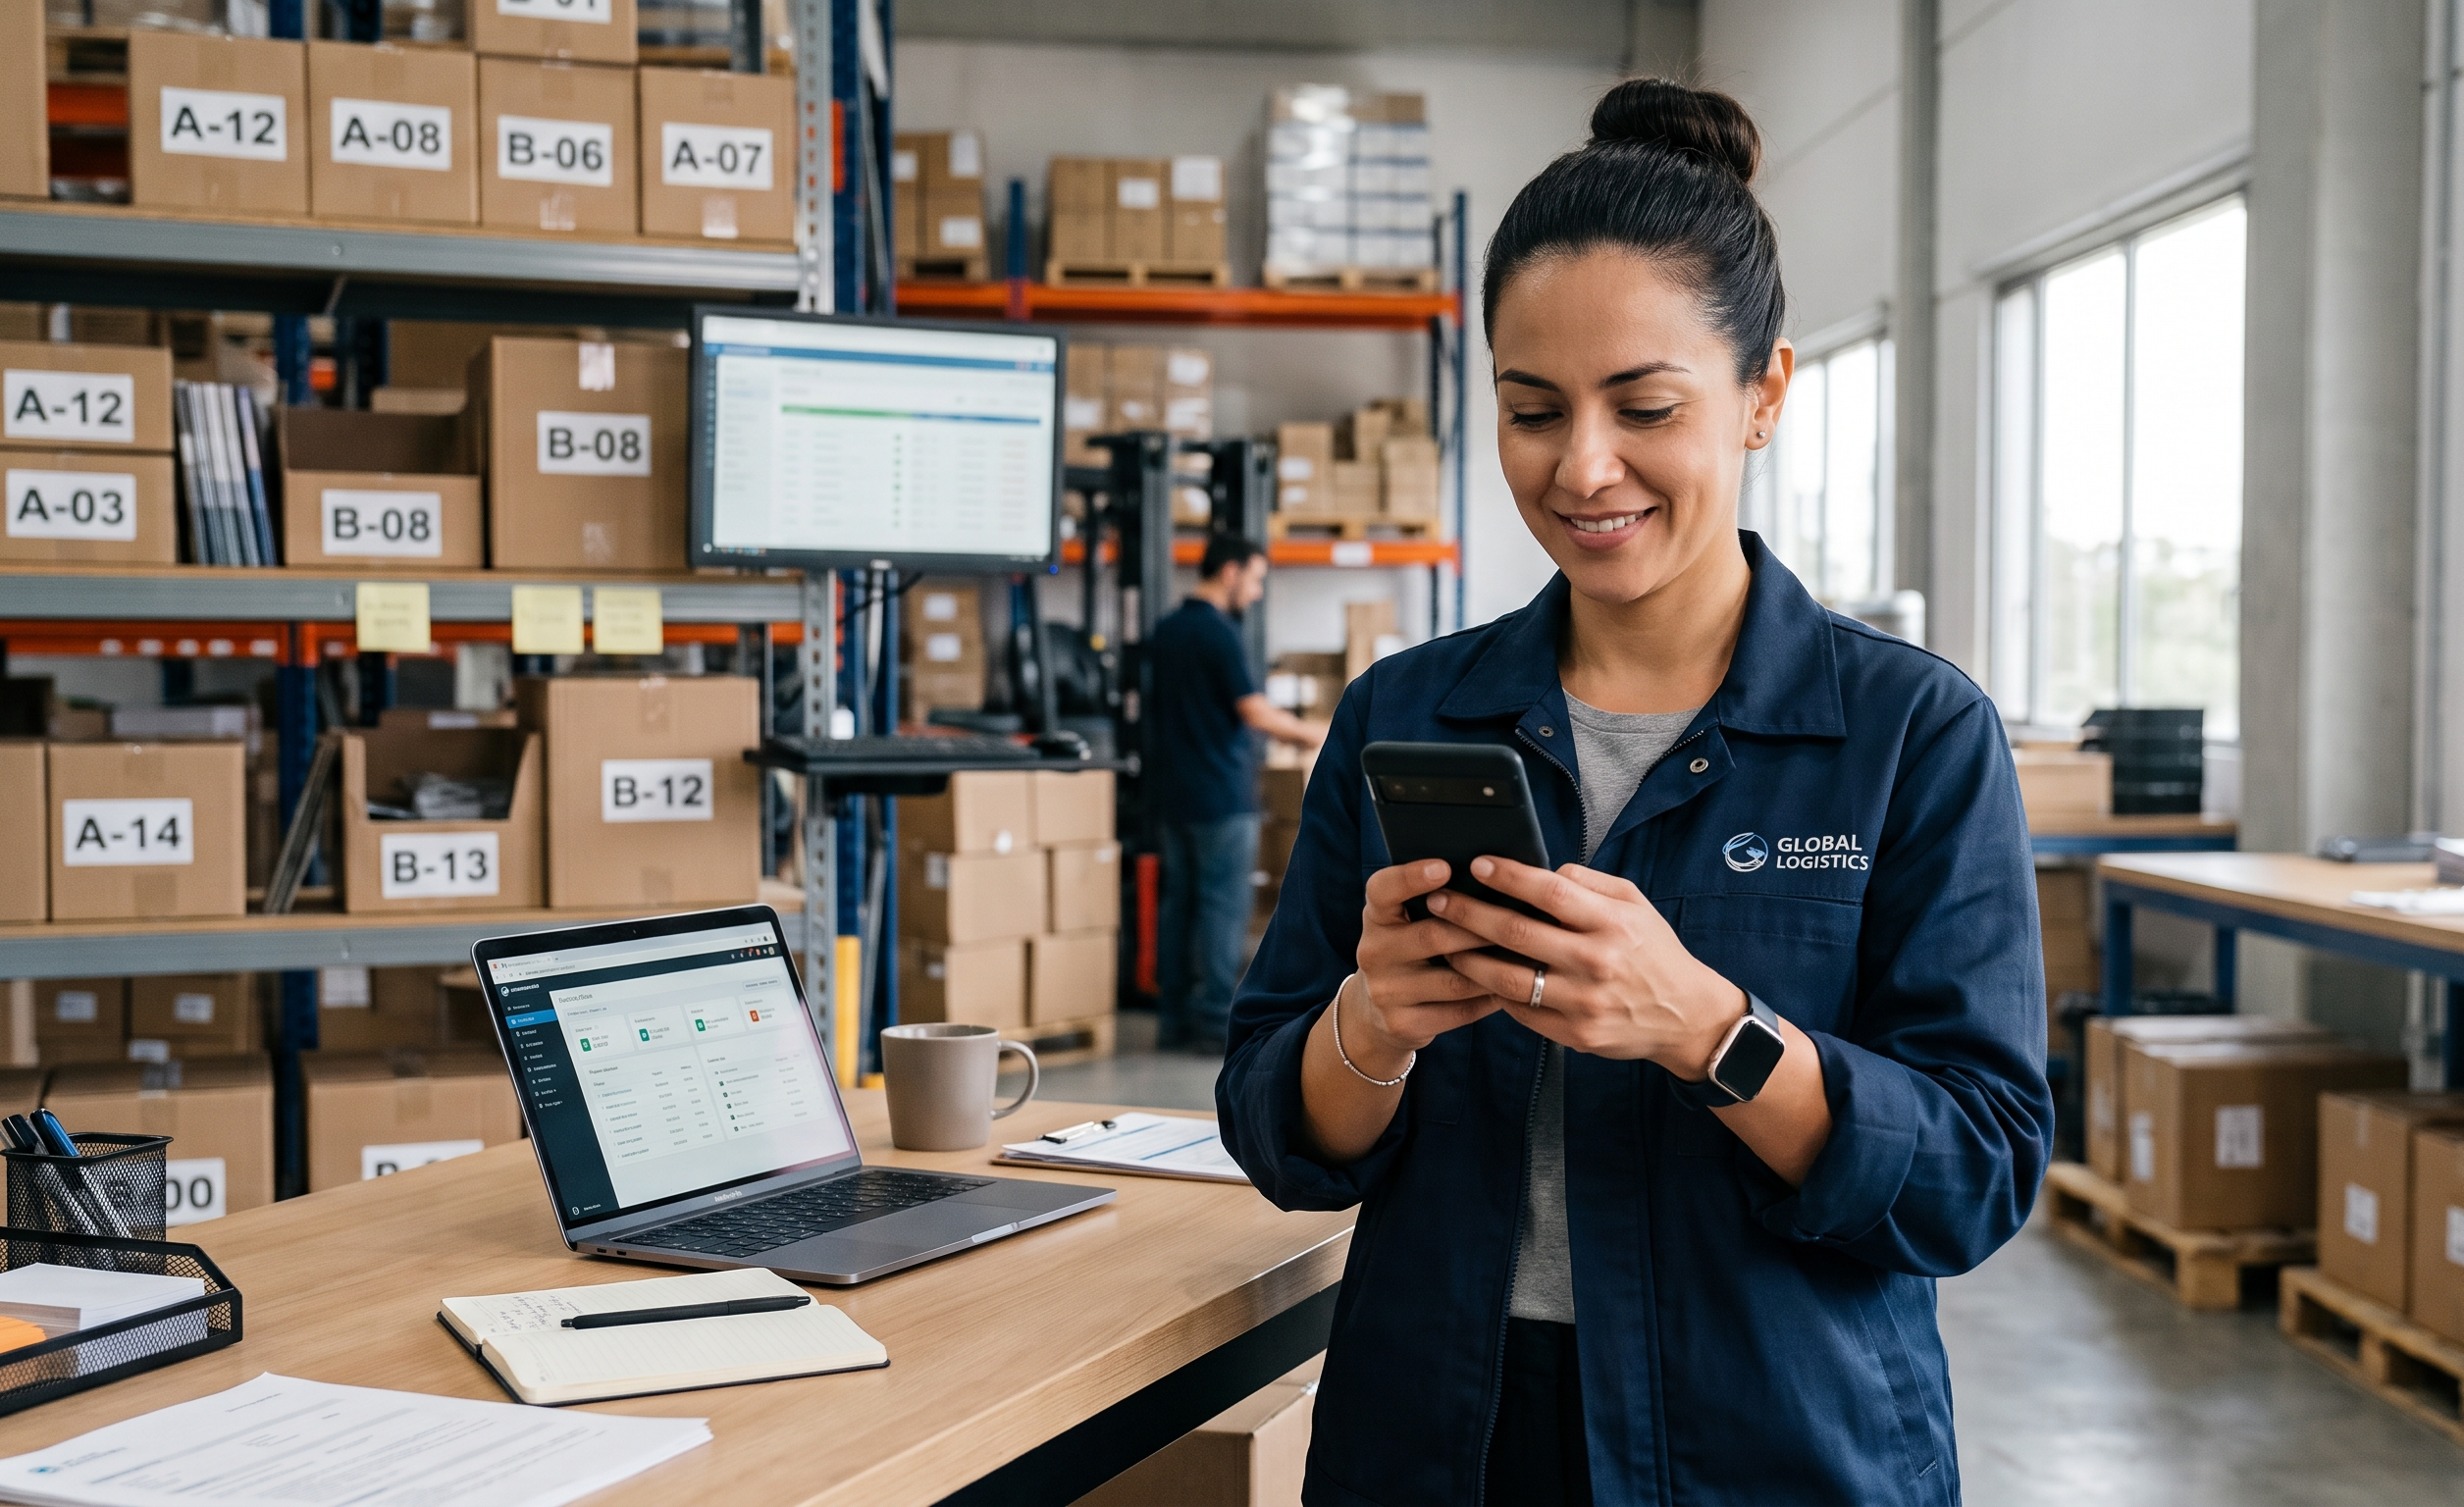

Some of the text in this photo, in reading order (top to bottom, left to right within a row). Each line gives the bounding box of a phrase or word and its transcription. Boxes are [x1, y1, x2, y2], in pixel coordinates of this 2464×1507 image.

[171, 105, 276, 145] A-12
[340, 116, 442, 155] A-08
[507, 131, 603, 171] B-06
[672, 139, 762, 174] A-07
[14, 387, 123, 426] A-12
[548, 427, 643, 464] B-08
[17, 488, 125, 526] A-03
[333, 506, 431, 543] B-08
[612, 774, 705, 807] B-12
[75, 815, 183, 851] A-14
[1777, 834, 1862, 853] GLOBAL
[393, 849, 490, 884] B-13
[1776, 854, 1869, 871] LOGISTICS
